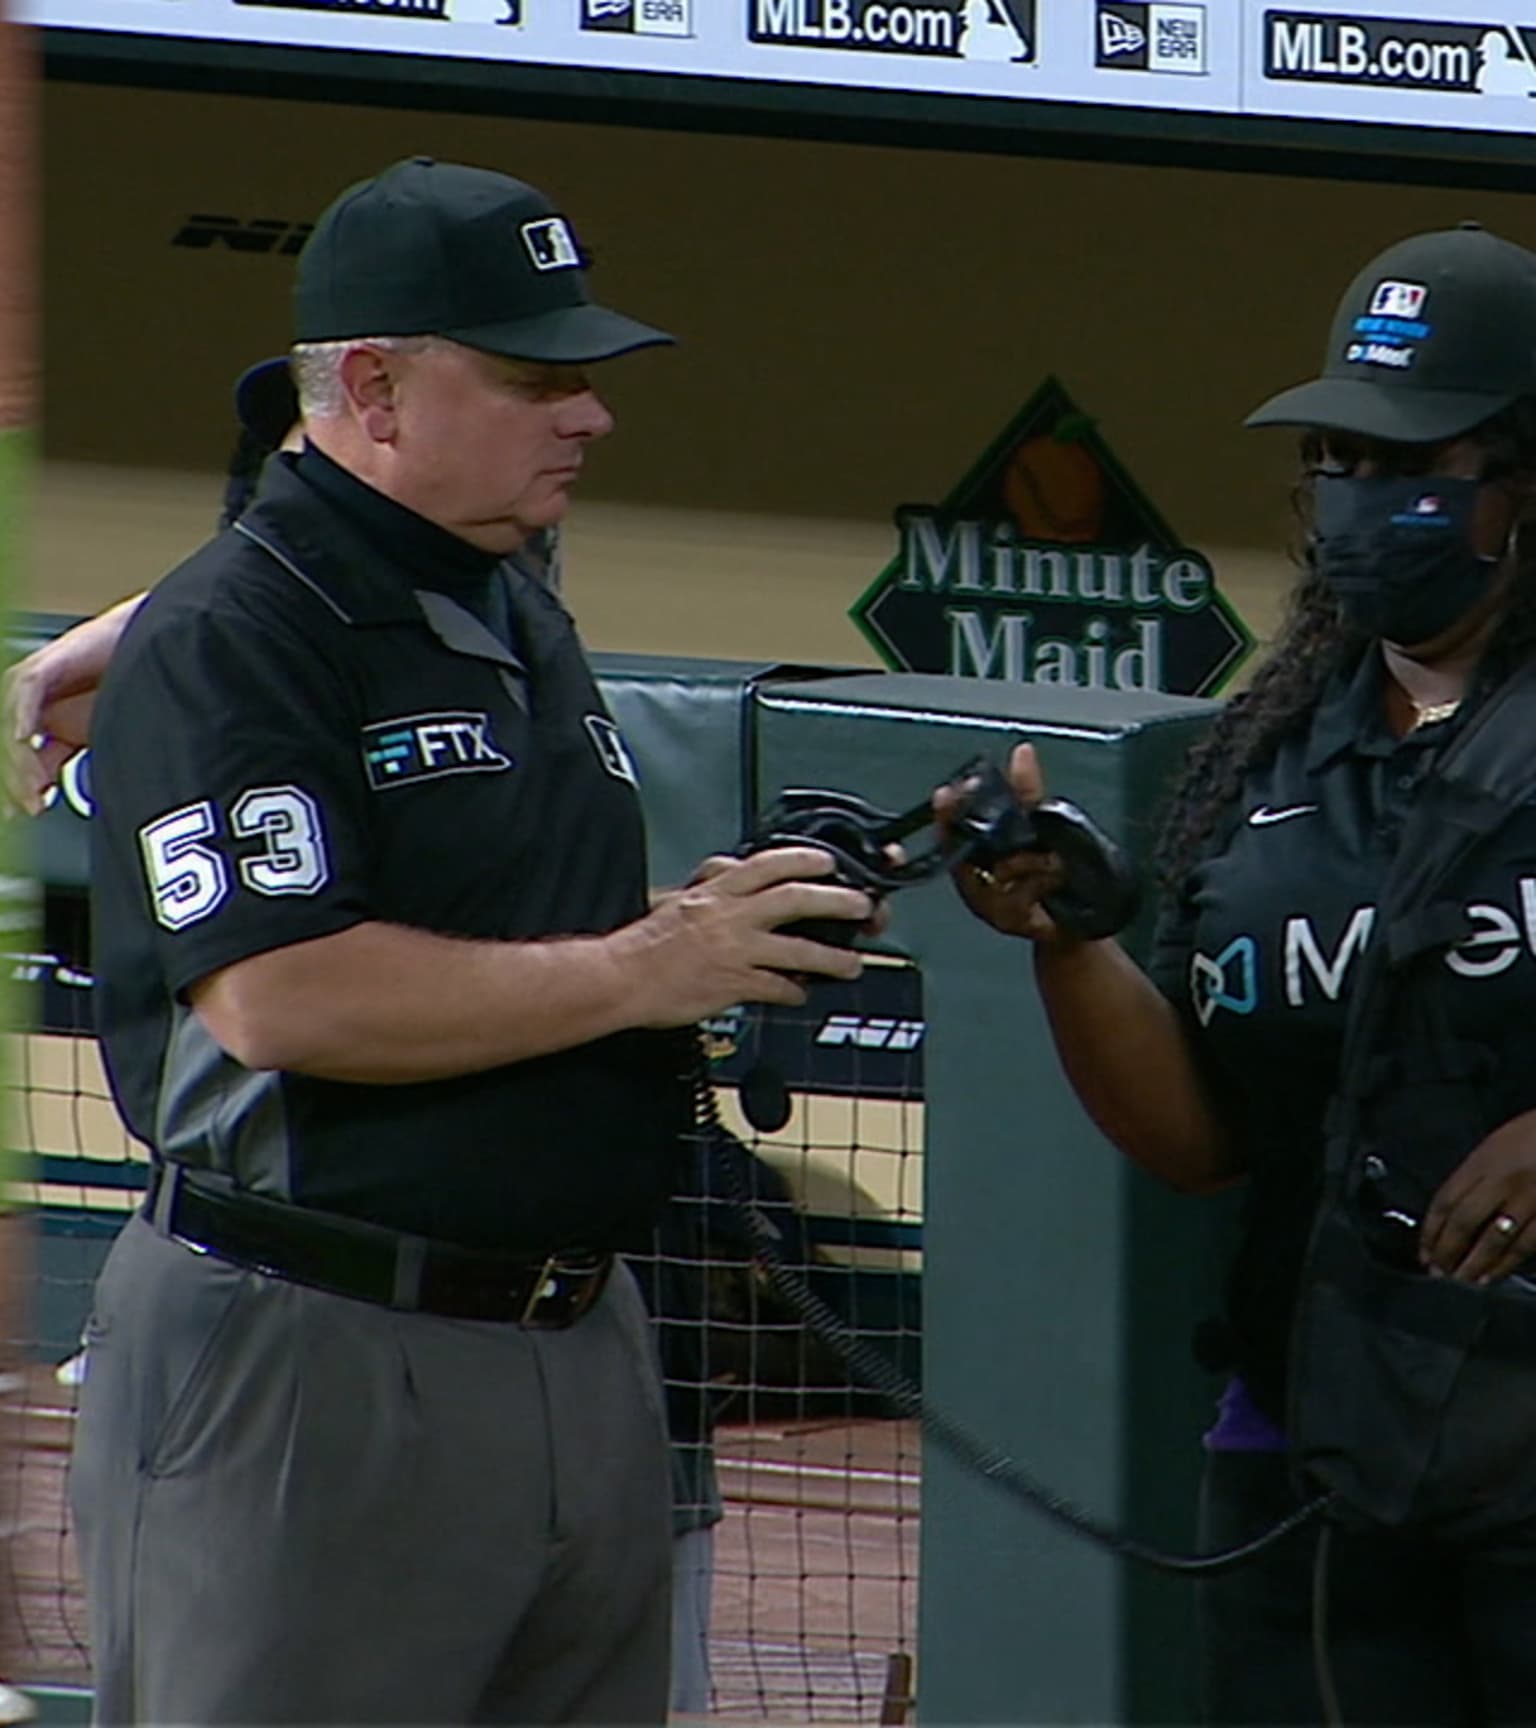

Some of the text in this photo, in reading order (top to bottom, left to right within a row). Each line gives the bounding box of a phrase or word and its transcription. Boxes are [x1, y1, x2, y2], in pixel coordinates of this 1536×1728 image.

[755, 0, 953, 47] MLB.com
[1156, 18, 1198, 39] NEW
[1156, 38, 1198, 59] ERA
[1271, 20, 1470, 83] MLB.com
[900, 515, 1209, 608] Minute
[948, 609, 1162, 693] Maid
[416, 722, 499, 768] FTX
[139, 783, 330, 932] 53
